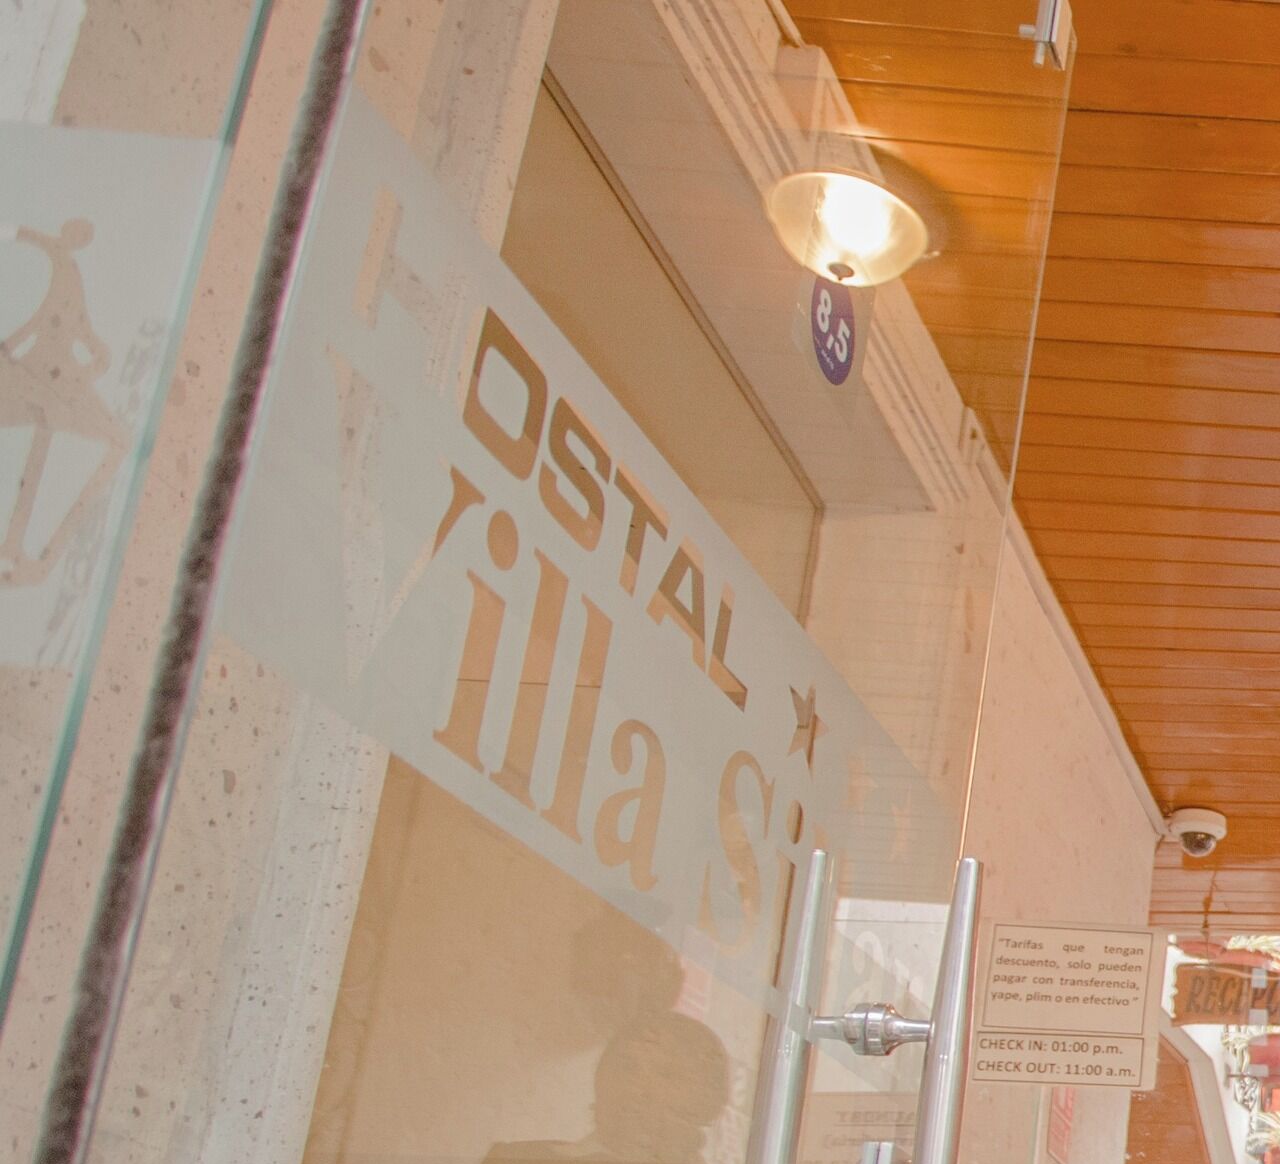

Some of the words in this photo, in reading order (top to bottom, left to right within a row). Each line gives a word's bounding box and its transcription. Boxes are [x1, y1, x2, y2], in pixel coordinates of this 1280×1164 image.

[1062, 943, 1085, 953] que
[1104, 945, 1144, 957] tengan
[995, 955, 1060, 969] descuento,
[1067, 960, 1092, 970] solo
[1098, 960, 1142, 972] pueden
[993, 974, 1027, 984] pagar
[1032, 976, 1053, 984] con
[1060, 977, 1140, 990] transferencia,
[990, 990, 1023, 1001] yape,
[1082, 995, 1130, 1006] efectivo
[979, 1038, 1024, 1050] CHECK
[1028, 1041, 1047, 1052] IN:
[1051, 1041, 1089, 1053] 01:00
[1093, 1044, 1123, 1055] p.m.
[977, 1060, 1021, 1073] CHECK
[1026, 1062, 1060, 1074] OUT:
[1065, 1063, 1102, 1075] 11:00
[1106, 1066, 1136, 1077] a.m.
